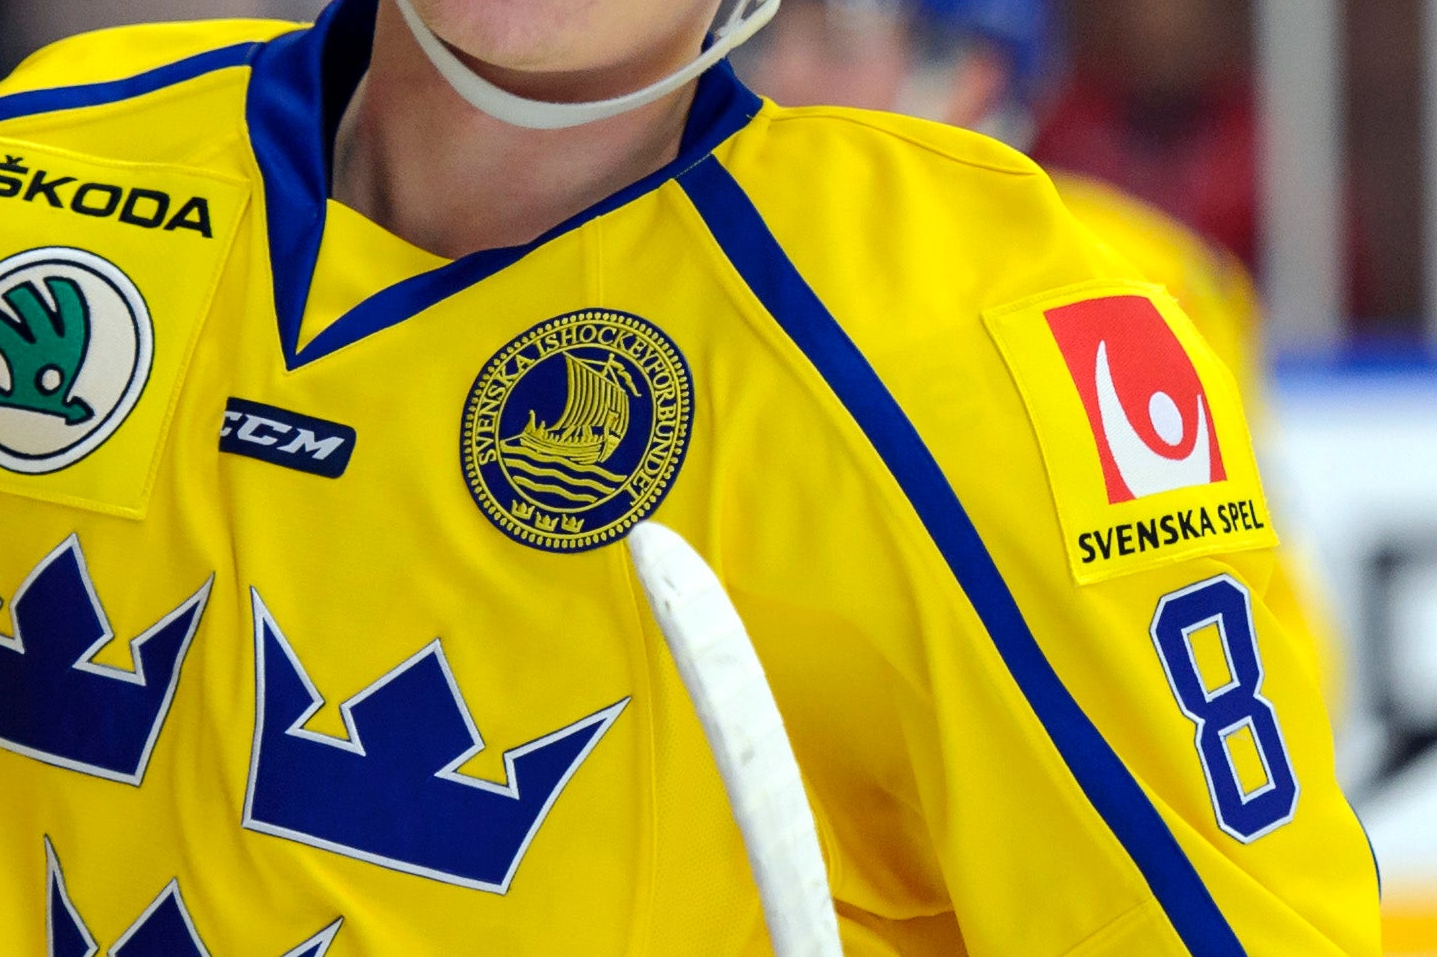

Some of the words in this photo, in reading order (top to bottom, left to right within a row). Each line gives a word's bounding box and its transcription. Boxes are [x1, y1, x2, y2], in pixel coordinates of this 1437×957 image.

[477, 352, 536, 467] SVENSKA
[1078, 507, 1217, 564] SVENSKA
[1217, 499, 1265, 534] SPEL
